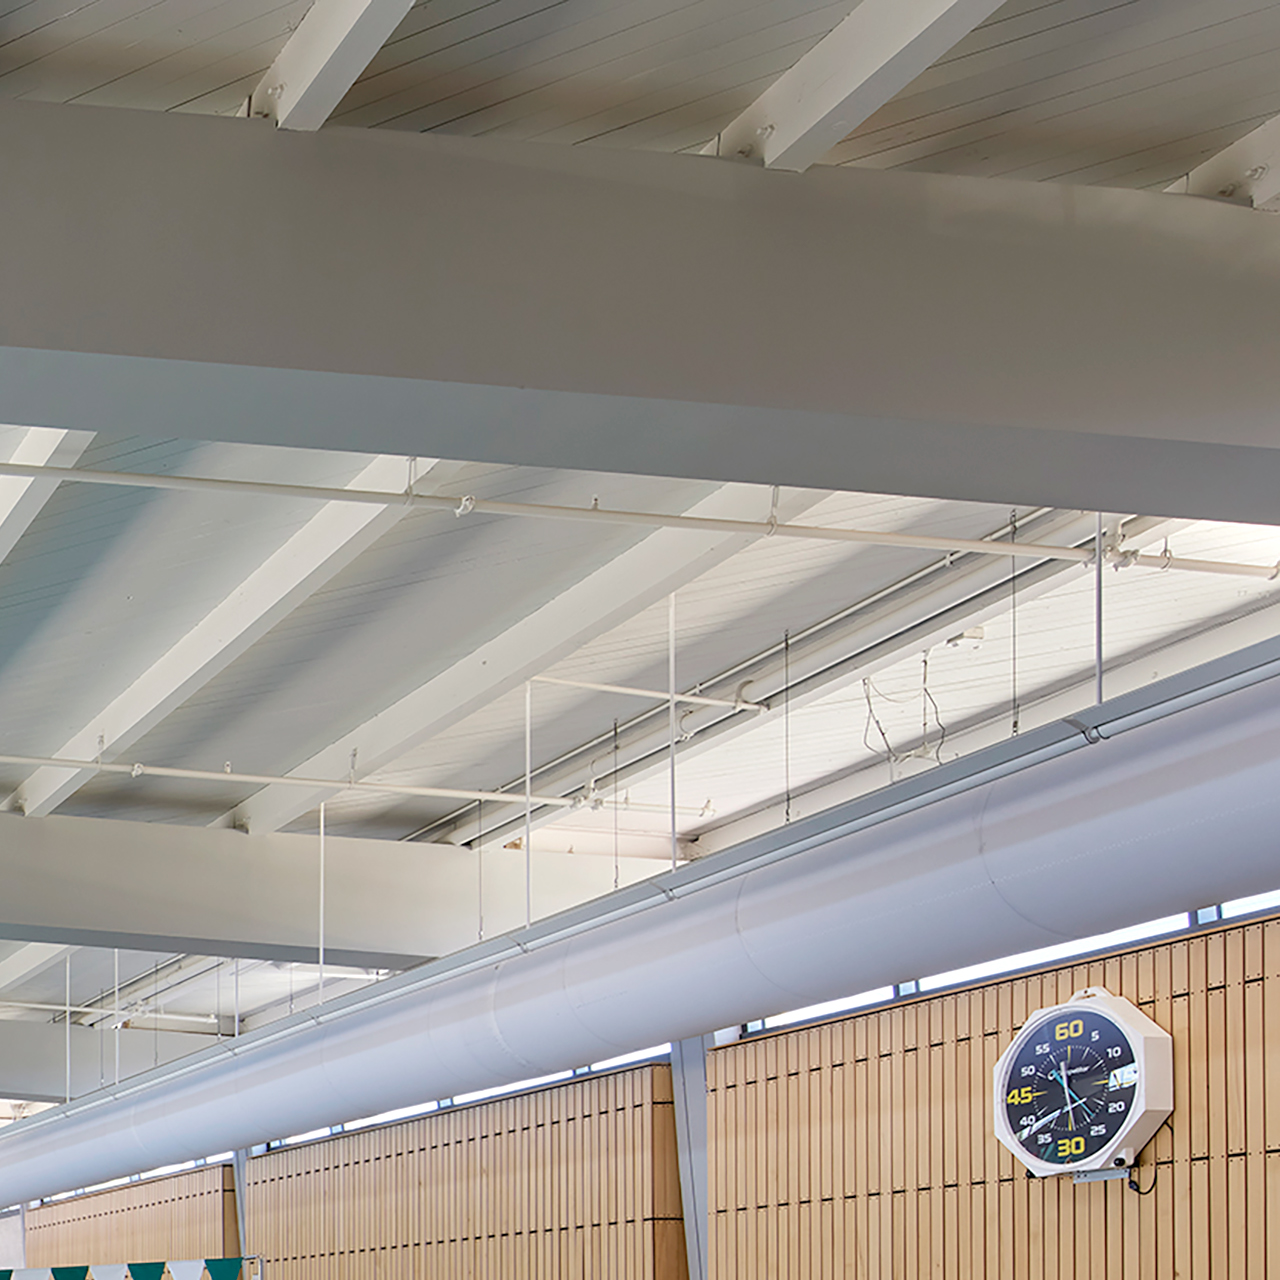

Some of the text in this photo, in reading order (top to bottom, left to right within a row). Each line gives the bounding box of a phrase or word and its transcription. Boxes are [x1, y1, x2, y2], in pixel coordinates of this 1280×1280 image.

[1055, 1019, 1084, 1041] 60
[1091, 1030, 1100, 1041] 5
[1035, 1043, 1050, 1055] 55
[1106, 1046, 1122, 1058] 10
[1021, 1065, 1036, 1077] 50
[1007, 1086, 1033, 1105] 45
[1108, 1101, 1125, 1113] 20
[1020, 1115, 1036, 1126] 40
[1091, 1124, 1107, 1136] 25
[1037, 1133, 1052, 1144] 35
[1057, 1136, 1085, 1157] 30
